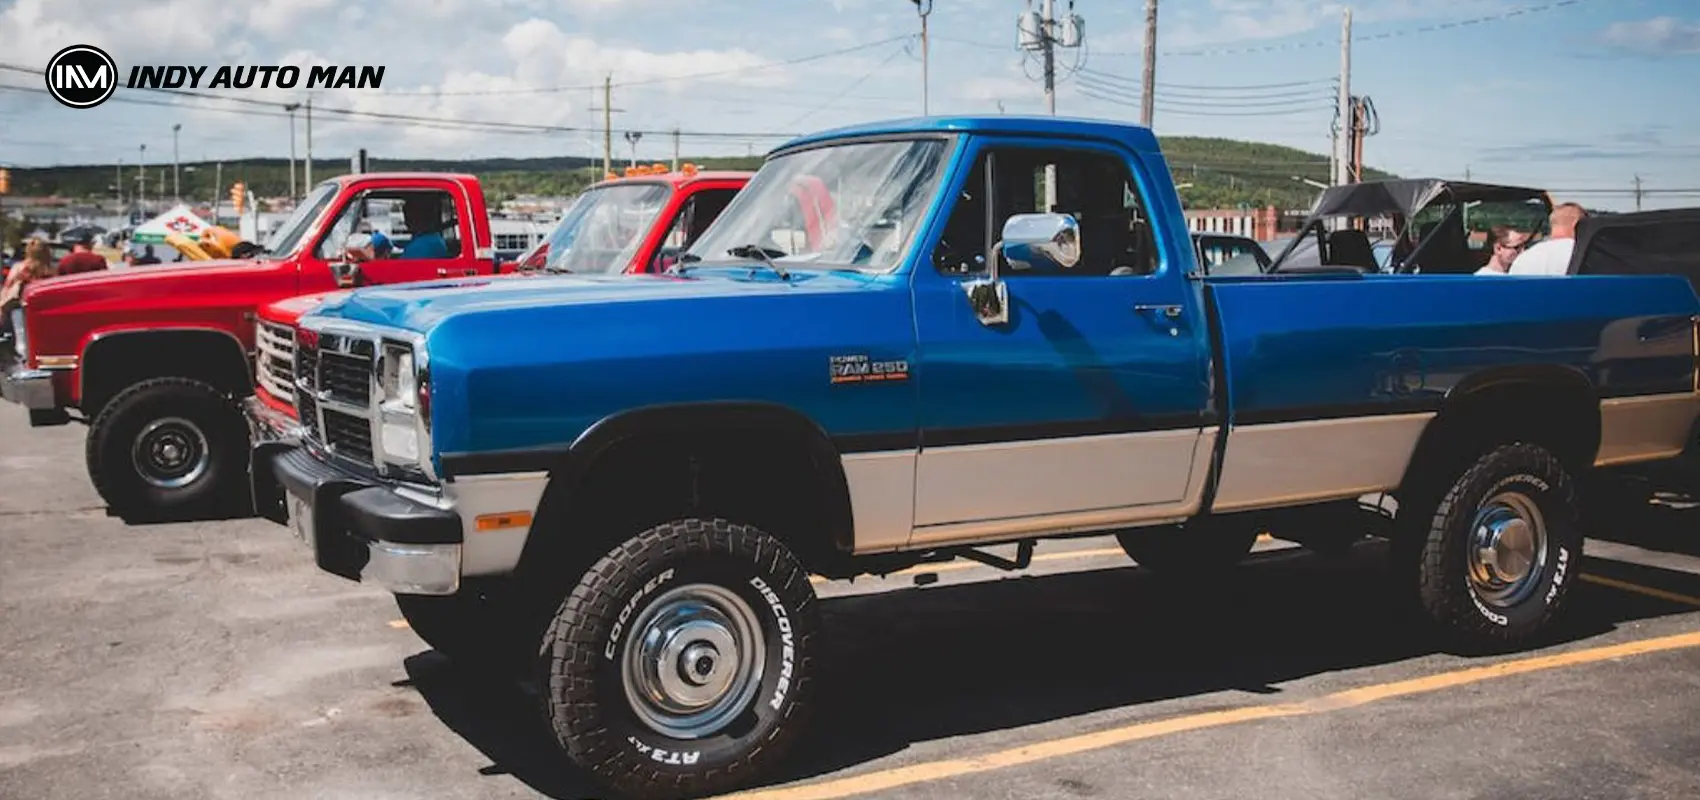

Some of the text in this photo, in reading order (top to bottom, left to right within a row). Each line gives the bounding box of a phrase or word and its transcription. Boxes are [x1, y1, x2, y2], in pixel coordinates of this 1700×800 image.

[830, 361, 908, 376] RAM 250
[1554, 547, 1569, 586] AT3
[606, 567, 675, 661] COOPER
[749, 576, 797, 710] DISCOVERER
[651, 748, 701, 766] AT3
